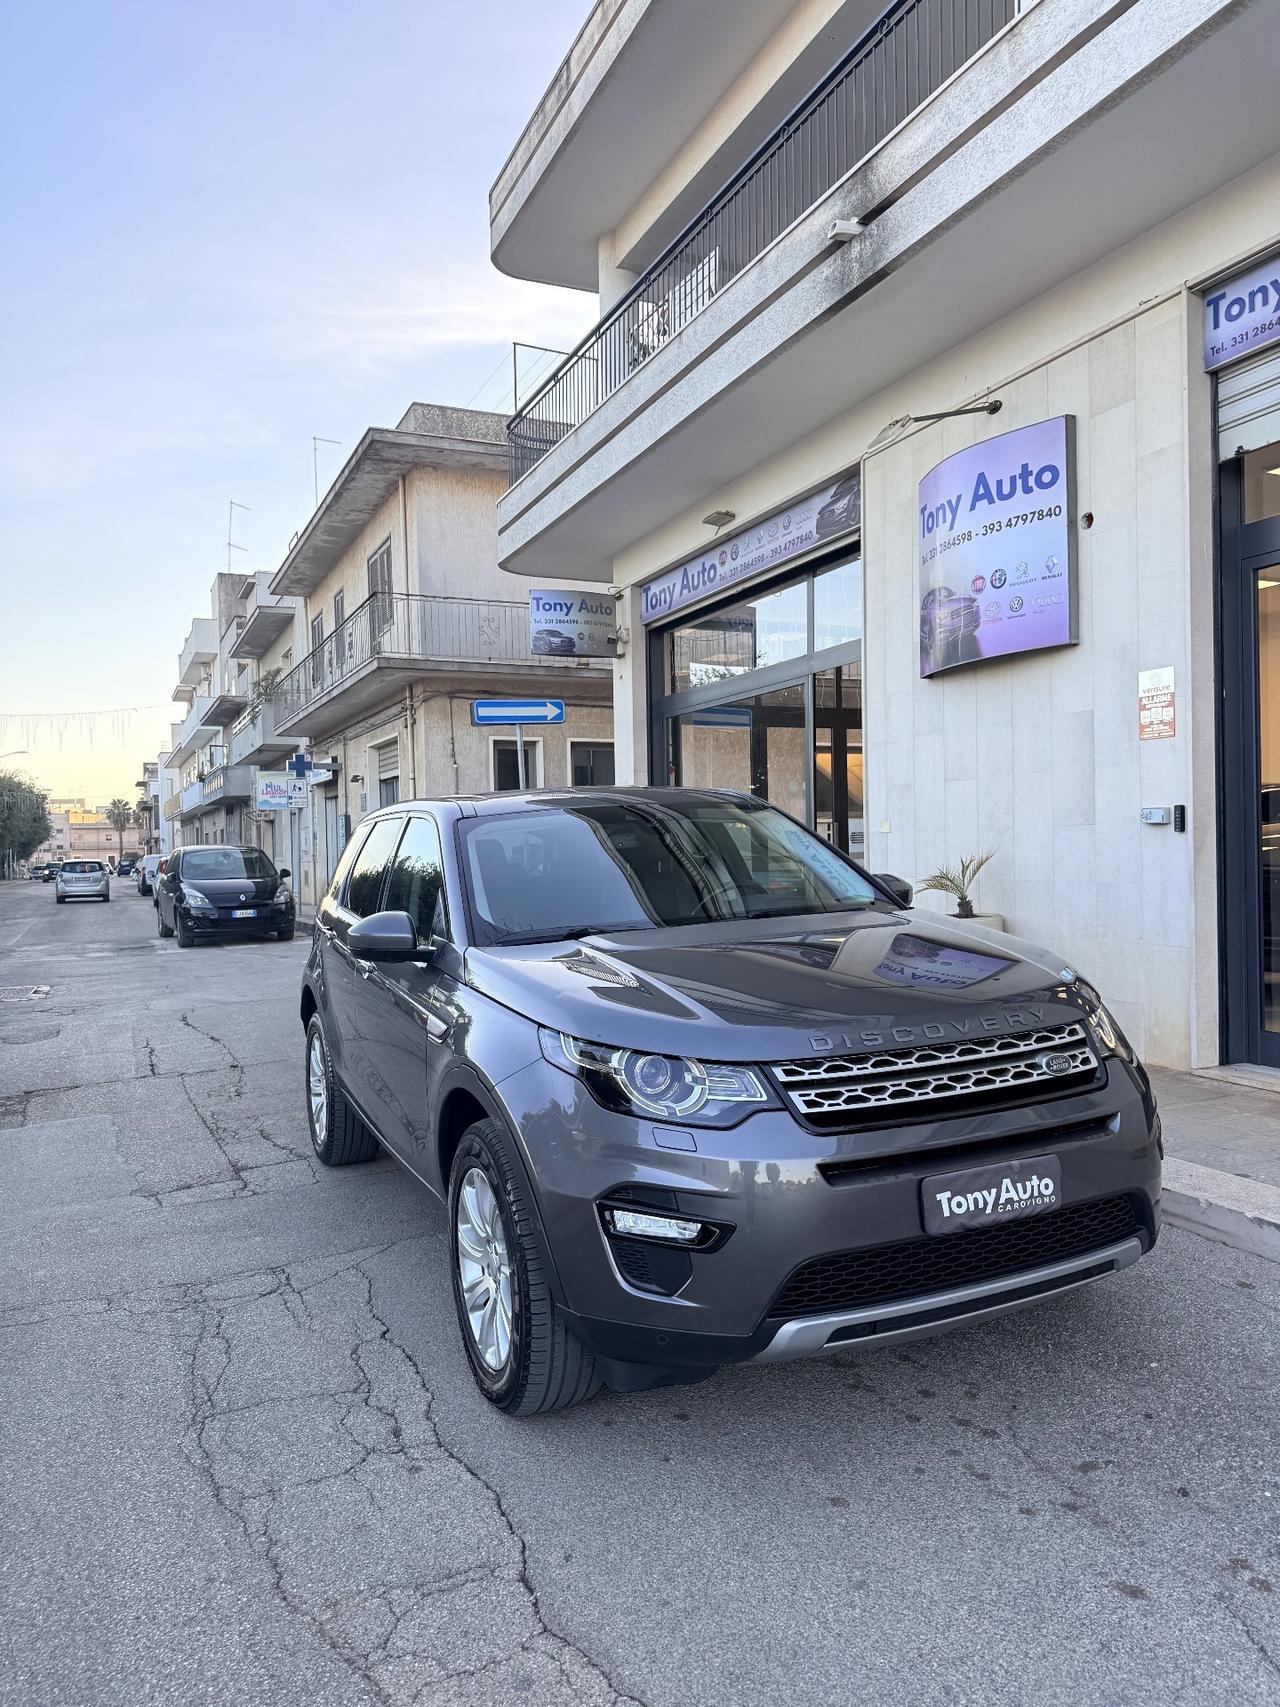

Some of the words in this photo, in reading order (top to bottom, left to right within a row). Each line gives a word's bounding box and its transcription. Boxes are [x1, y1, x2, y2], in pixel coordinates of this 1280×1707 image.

[1210, 342, 1228, 357] Tel.
[1231, 331, 1249, 348] 331
[921, 493, 962, 539] Tony
[969, 462, 1060, 512] Auto
[939, 530, 973, 554] 2864598
[981, 520, 1003, 537] 393
[1005, 504, 1062, 529] 4797840
[770, 545, 782, 559] 393
[532, 597, 574, 617] Tony
[578, 598, 613, 616] Auto
[642, 582, 676, 613] Tony
[679, 561, 717, 598] Auto
[807, 1008, 1046, 1052] DISCOVERY
